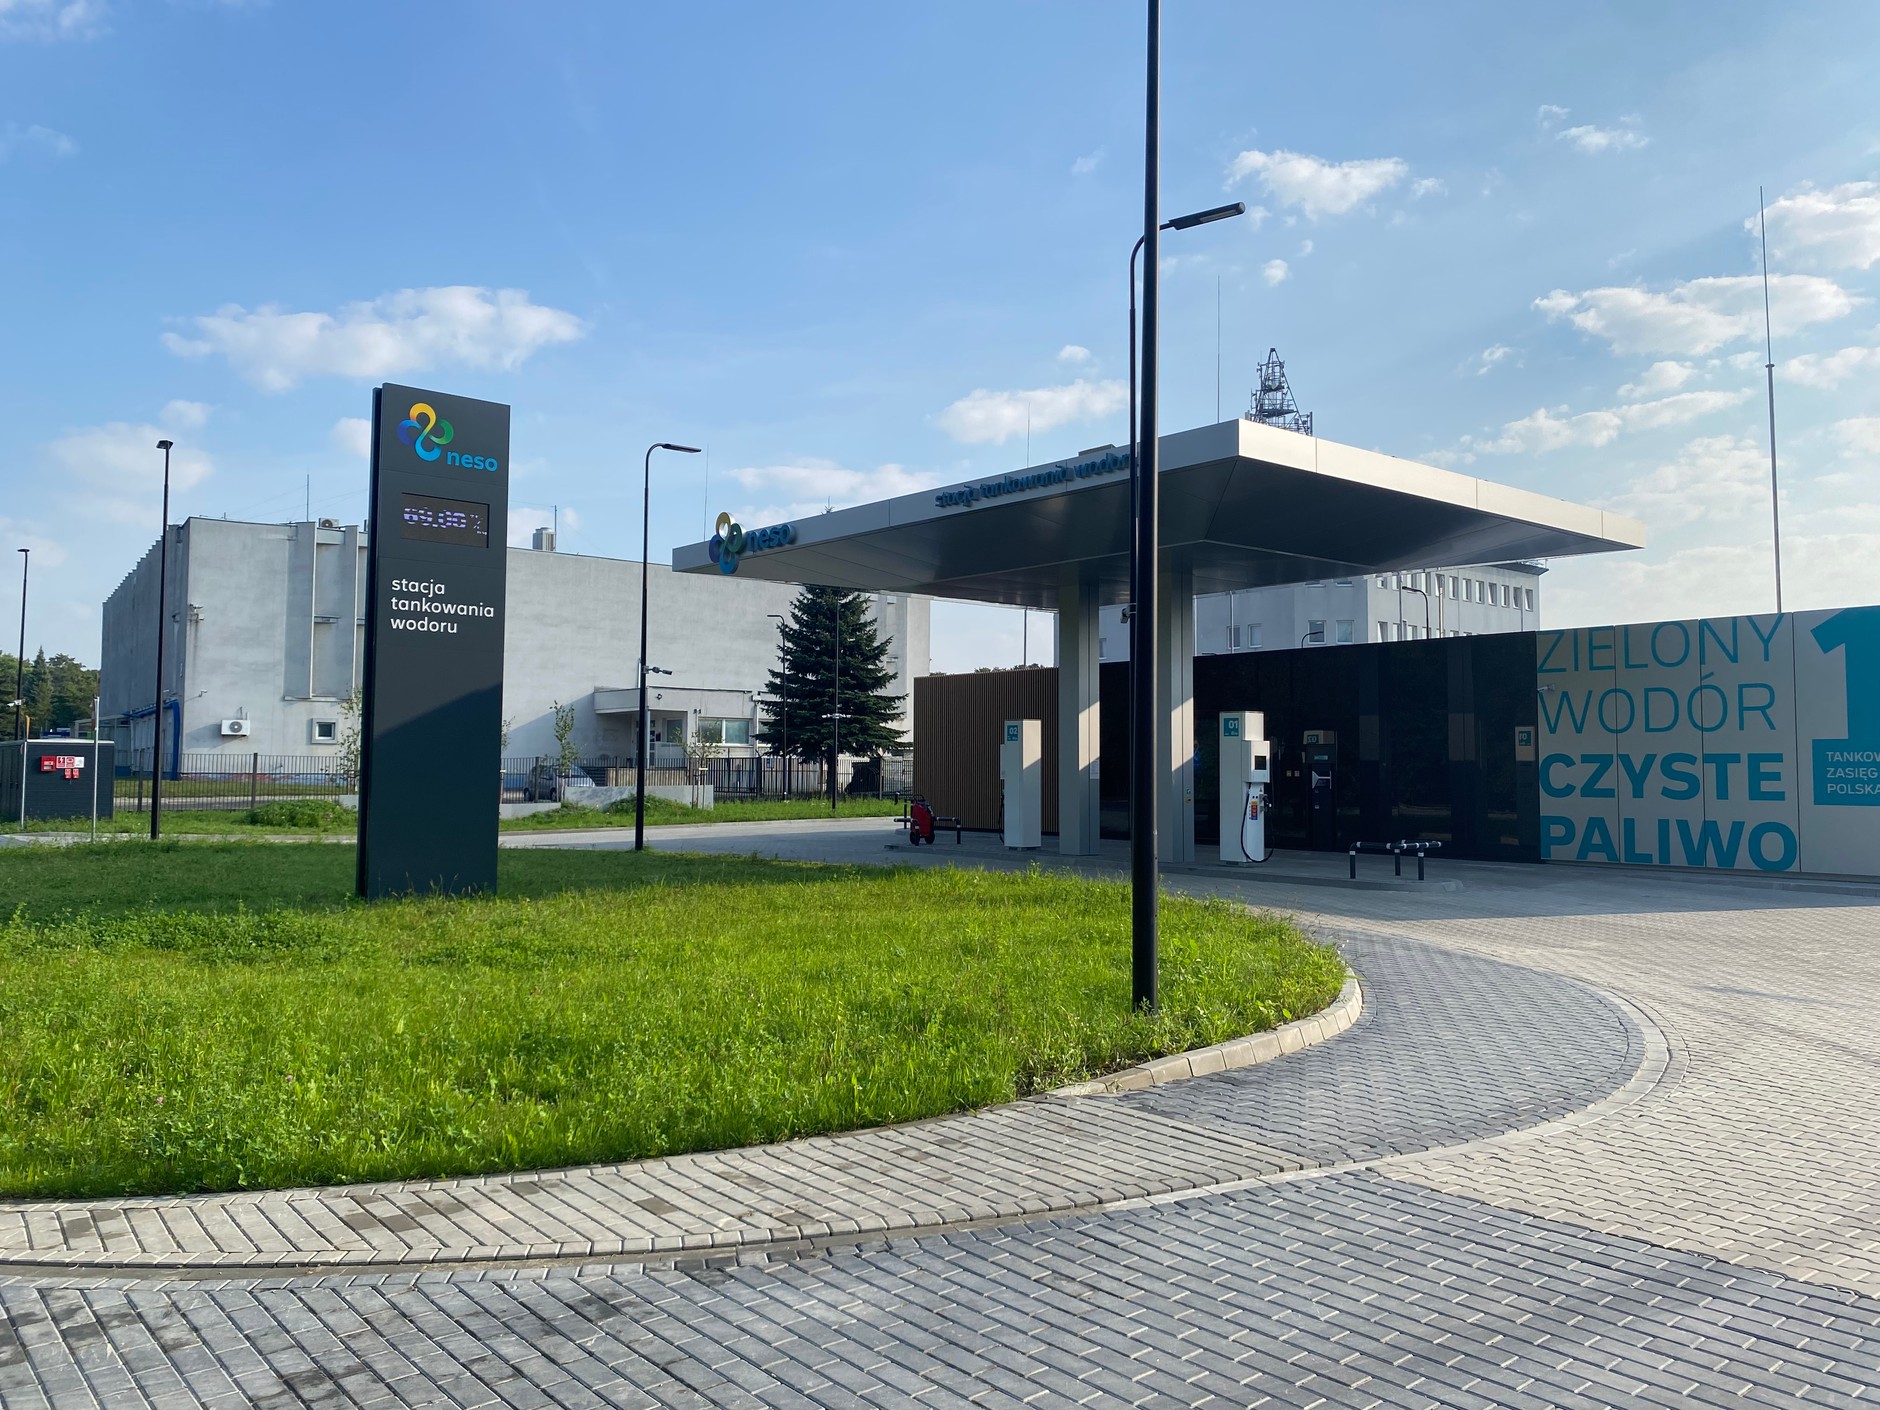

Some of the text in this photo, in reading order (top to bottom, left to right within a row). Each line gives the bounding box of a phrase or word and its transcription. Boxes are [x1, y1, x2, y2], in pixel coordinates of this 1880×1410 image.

[447, 451, 498, 472] neso
[935, 452, 1135, 507] stacja tankowania wodor
[746, 524, 793, 552] neso
[391, 578, 445, 597] stacja
[391, 597, 495, 618] tankowania
[390, 616, 458, 633] wodoru
[1537, 613, 1785, 673] ZIELONY
[1538, 672, 1777, 735] WODÓR
[1228, 720, 1239, 729] 01
[1539, 752, 1786, 801] CZYSTE
[1826, 767, 1878, 780] ZASIĘG
[1540, 815, 1798, 872] PALIWO
